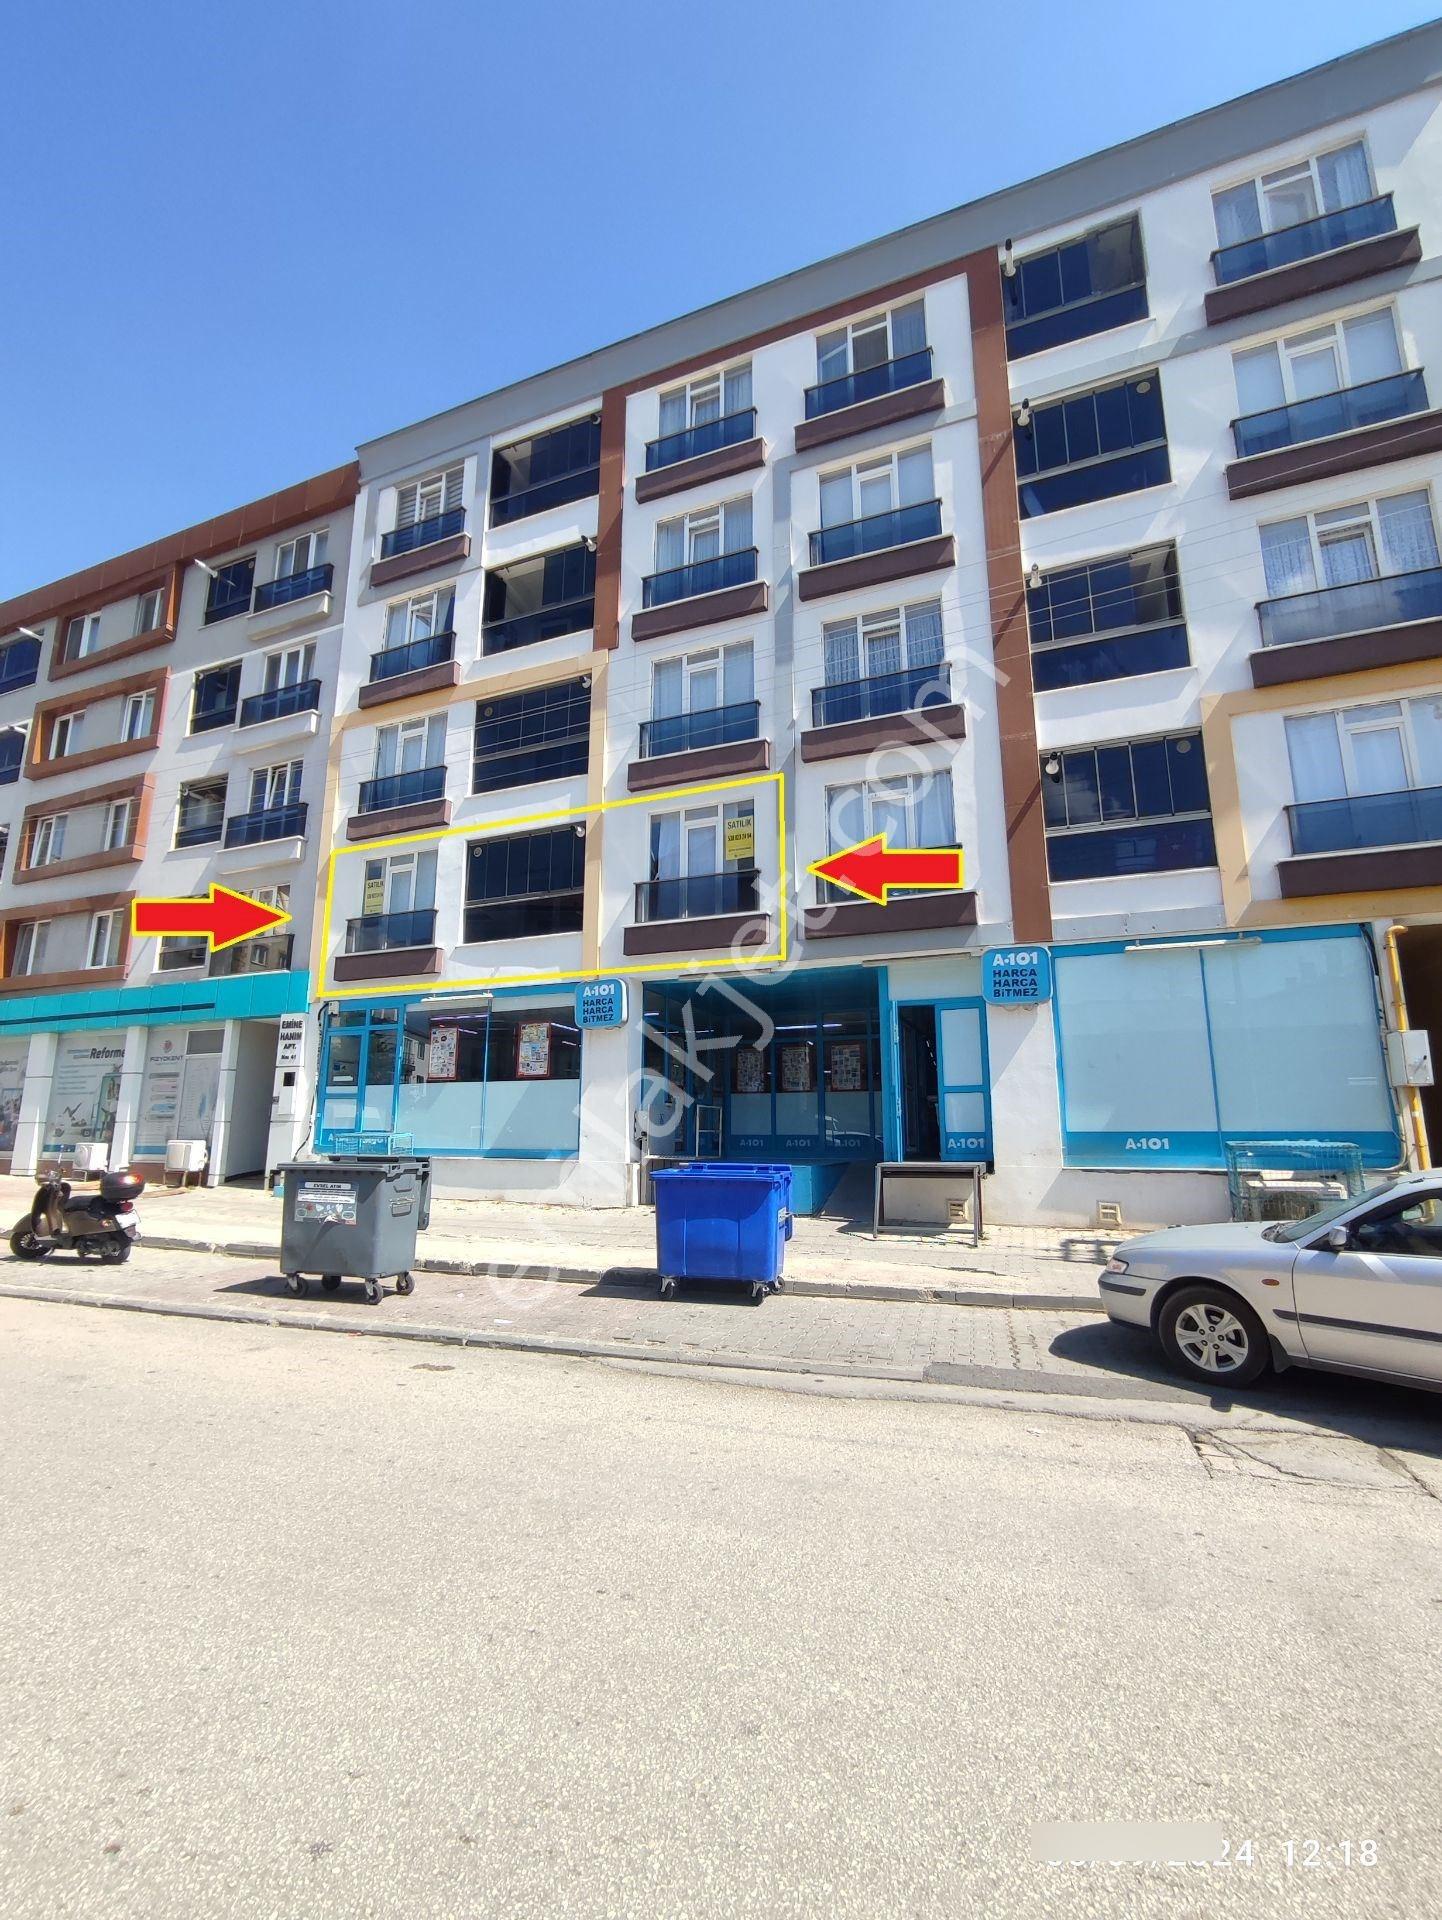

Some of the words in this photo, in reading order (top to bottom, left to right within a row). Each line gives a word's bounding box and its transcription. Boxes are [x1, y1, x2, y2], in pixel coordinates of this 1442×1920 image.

[728, 818, 752, 829] SATILIK
[993, 968, 1037, 978] HARCA
[993, 978, 1038, 988] HARCA
[583, 998, 614, 1007] HARCA
[583, 1006, 614, 1015] HARCA
[280, 1032, 302, 1040] HANIM
